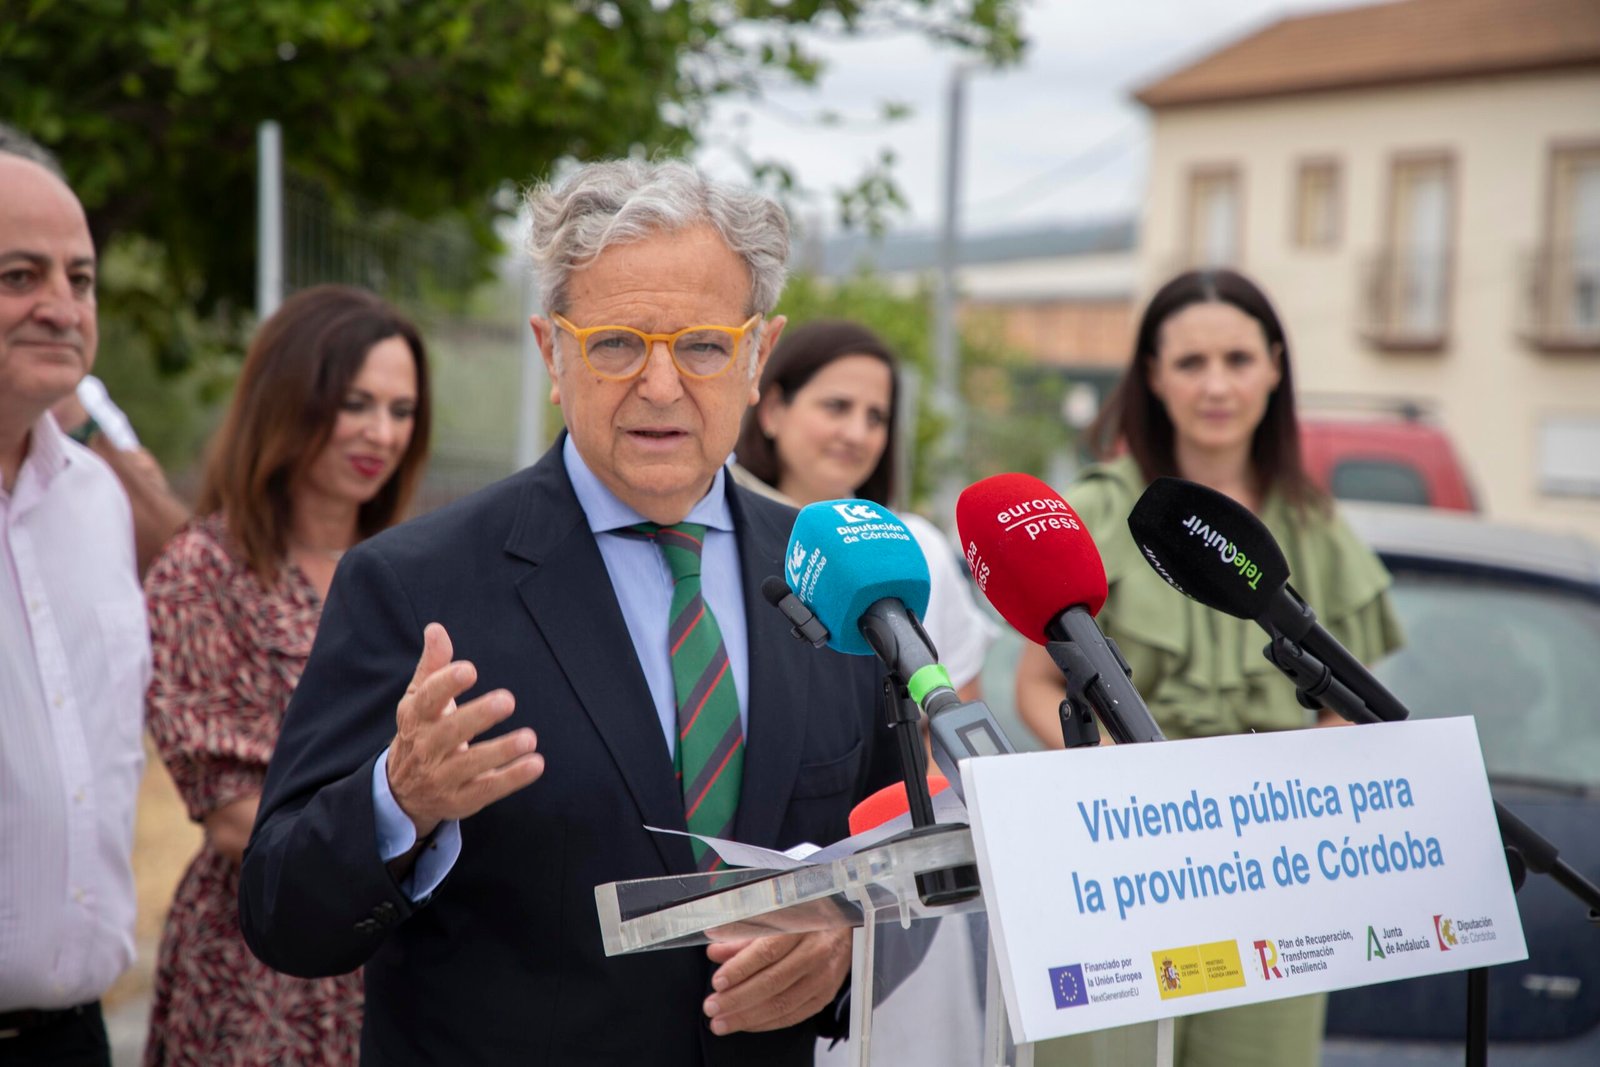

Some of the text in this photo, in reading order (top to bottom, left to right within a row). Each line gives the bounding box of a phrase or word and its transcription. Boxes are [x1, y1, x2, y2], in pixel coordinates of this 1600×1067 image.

[997, 498, 1068, 523] europa
[836, 522, 905, 536] Diputación
[843, 531, 911, 544] de Córdoba
[1024, 517, 1080, 541] press
[1182, 515, 1263, 590] TeleQuivir
[1077, 776, 1414, 843] Vivienda pública para
[1071, 831, 1445, 920] la provincia de Córdoba
[1457, 916, 1493, 931] Diputación
[1278, 929, 1354, 949] Plan de Recuperación,
[1383, 926, 1403, 939] Junta
[1460, 930, 1497, 945] de Córdoba
[1281, 945, 1335, 963] Transformación
[1385, 936, 1430, 955] de Andalucía
[1084, 958, 1132, 973] Financiado por
[1284, 960, 1327, 977] y Resiliencia
[1087, 971, 1142, 987] la Unión Europea
